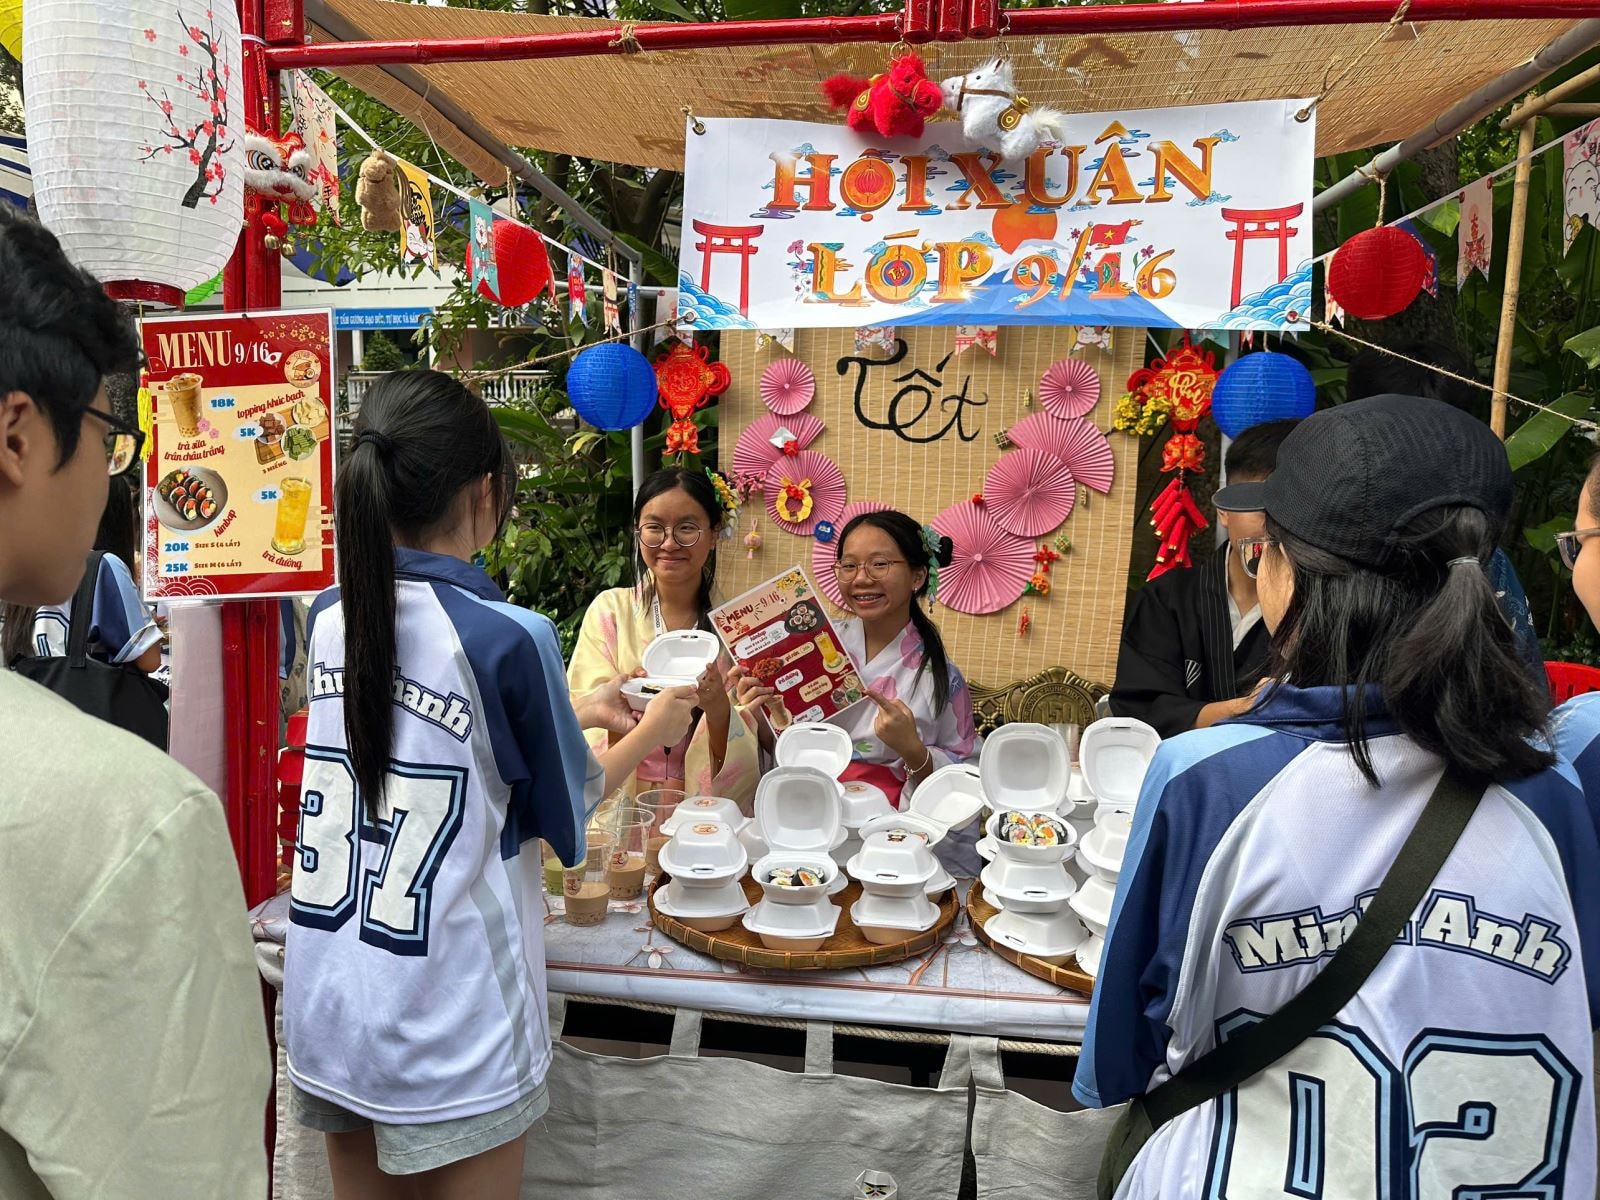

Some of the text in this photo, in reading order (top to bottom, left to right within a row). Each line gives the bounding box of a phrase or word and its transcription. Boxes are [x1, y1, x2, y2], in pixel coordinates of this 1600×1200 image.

[766, 119, 1222, 222] HỘI XUÂN
[803, 221, 1177, 311] LỚP 9/16
[156, 330, 269, 368] MENU 9/16
[211, 398, 235, 408] 18K
[237, 404, 266, 419] topping
[240, 427, 256, 437] 5K
[177, 441, 190, 451] trà
[261, 490, 277, 500] 5K
[213, 509, 237, 538] kimbap
[165, 542, 189, 552] 20K
[262, 550, 275, 563] trà
[165, 563, 188, 573] 25K
[726, 604, 754, 625] MENU
[289, 744, 469, 957] 37
[1224, 889, 1571, 985] Min Anh
